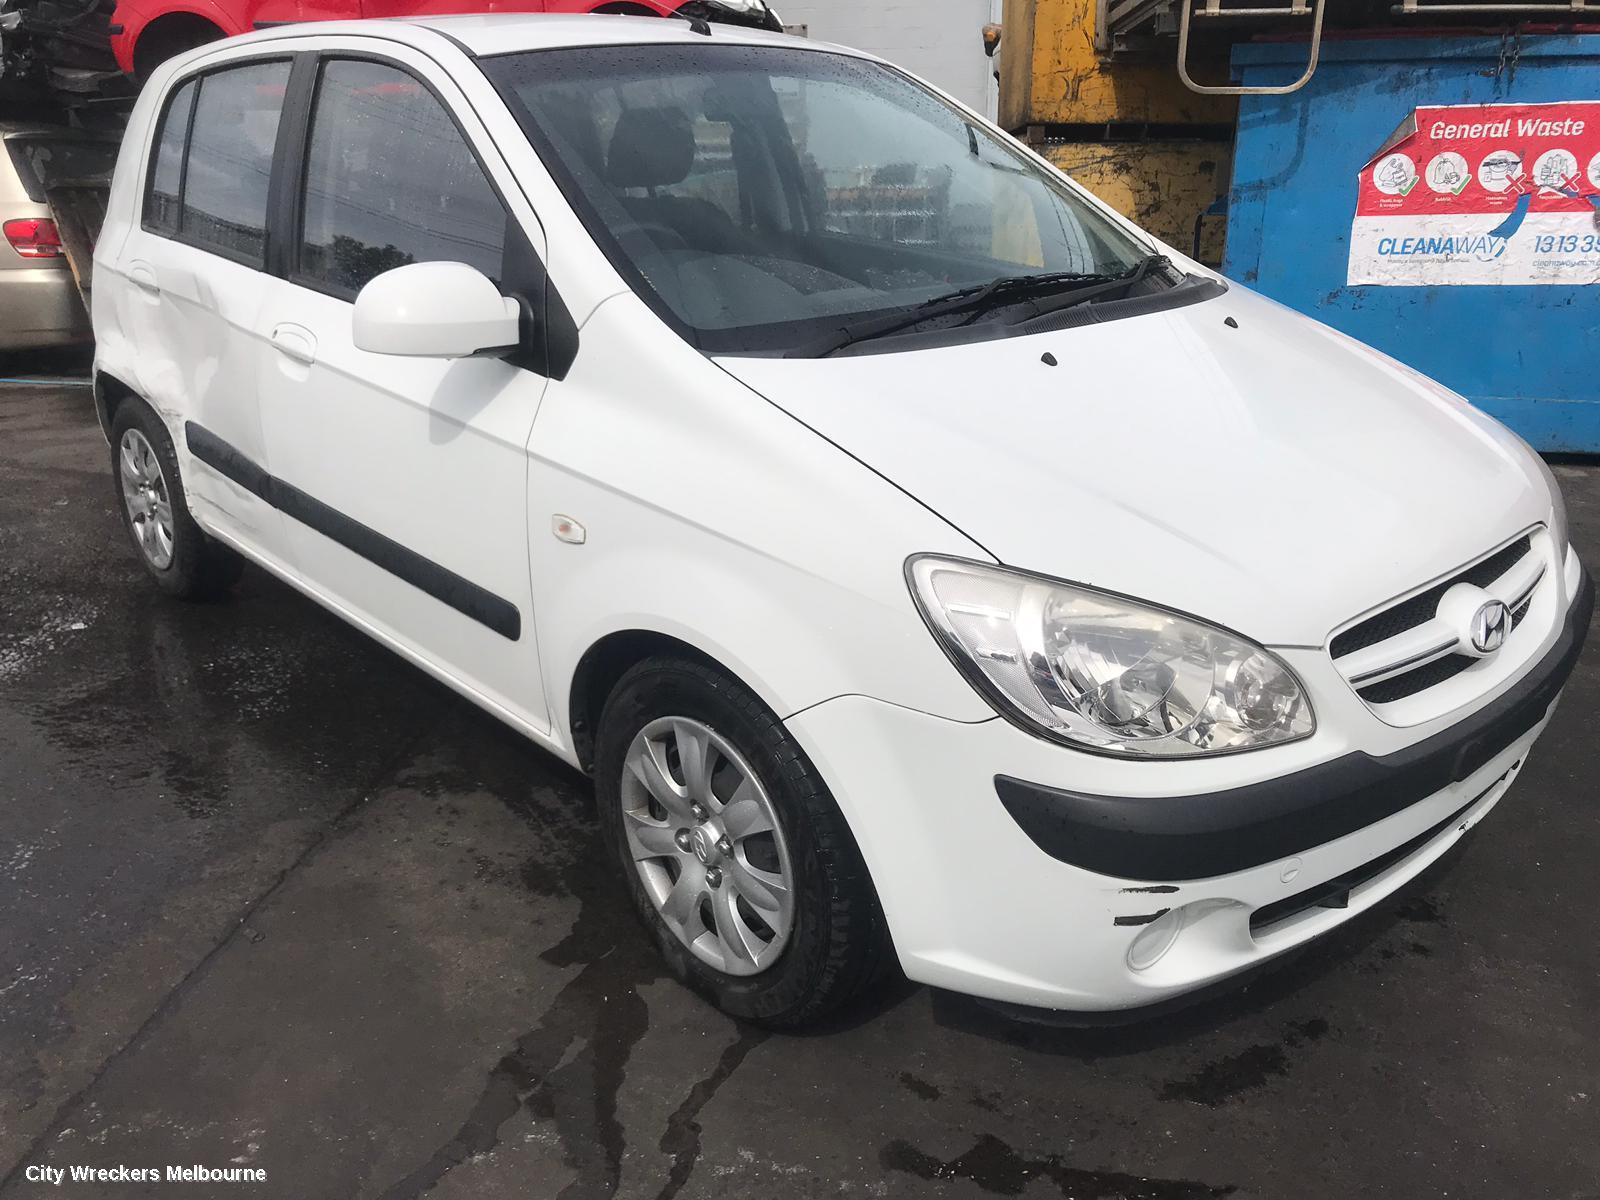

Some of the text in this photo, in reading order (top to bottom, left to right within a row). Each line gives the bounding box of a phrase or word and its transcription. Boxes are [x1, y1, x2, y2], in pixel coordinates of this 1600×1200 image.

[1430, 118, 1585, 139] General Waste
[1377, 236, 1500, 255] CLEANAWAY
